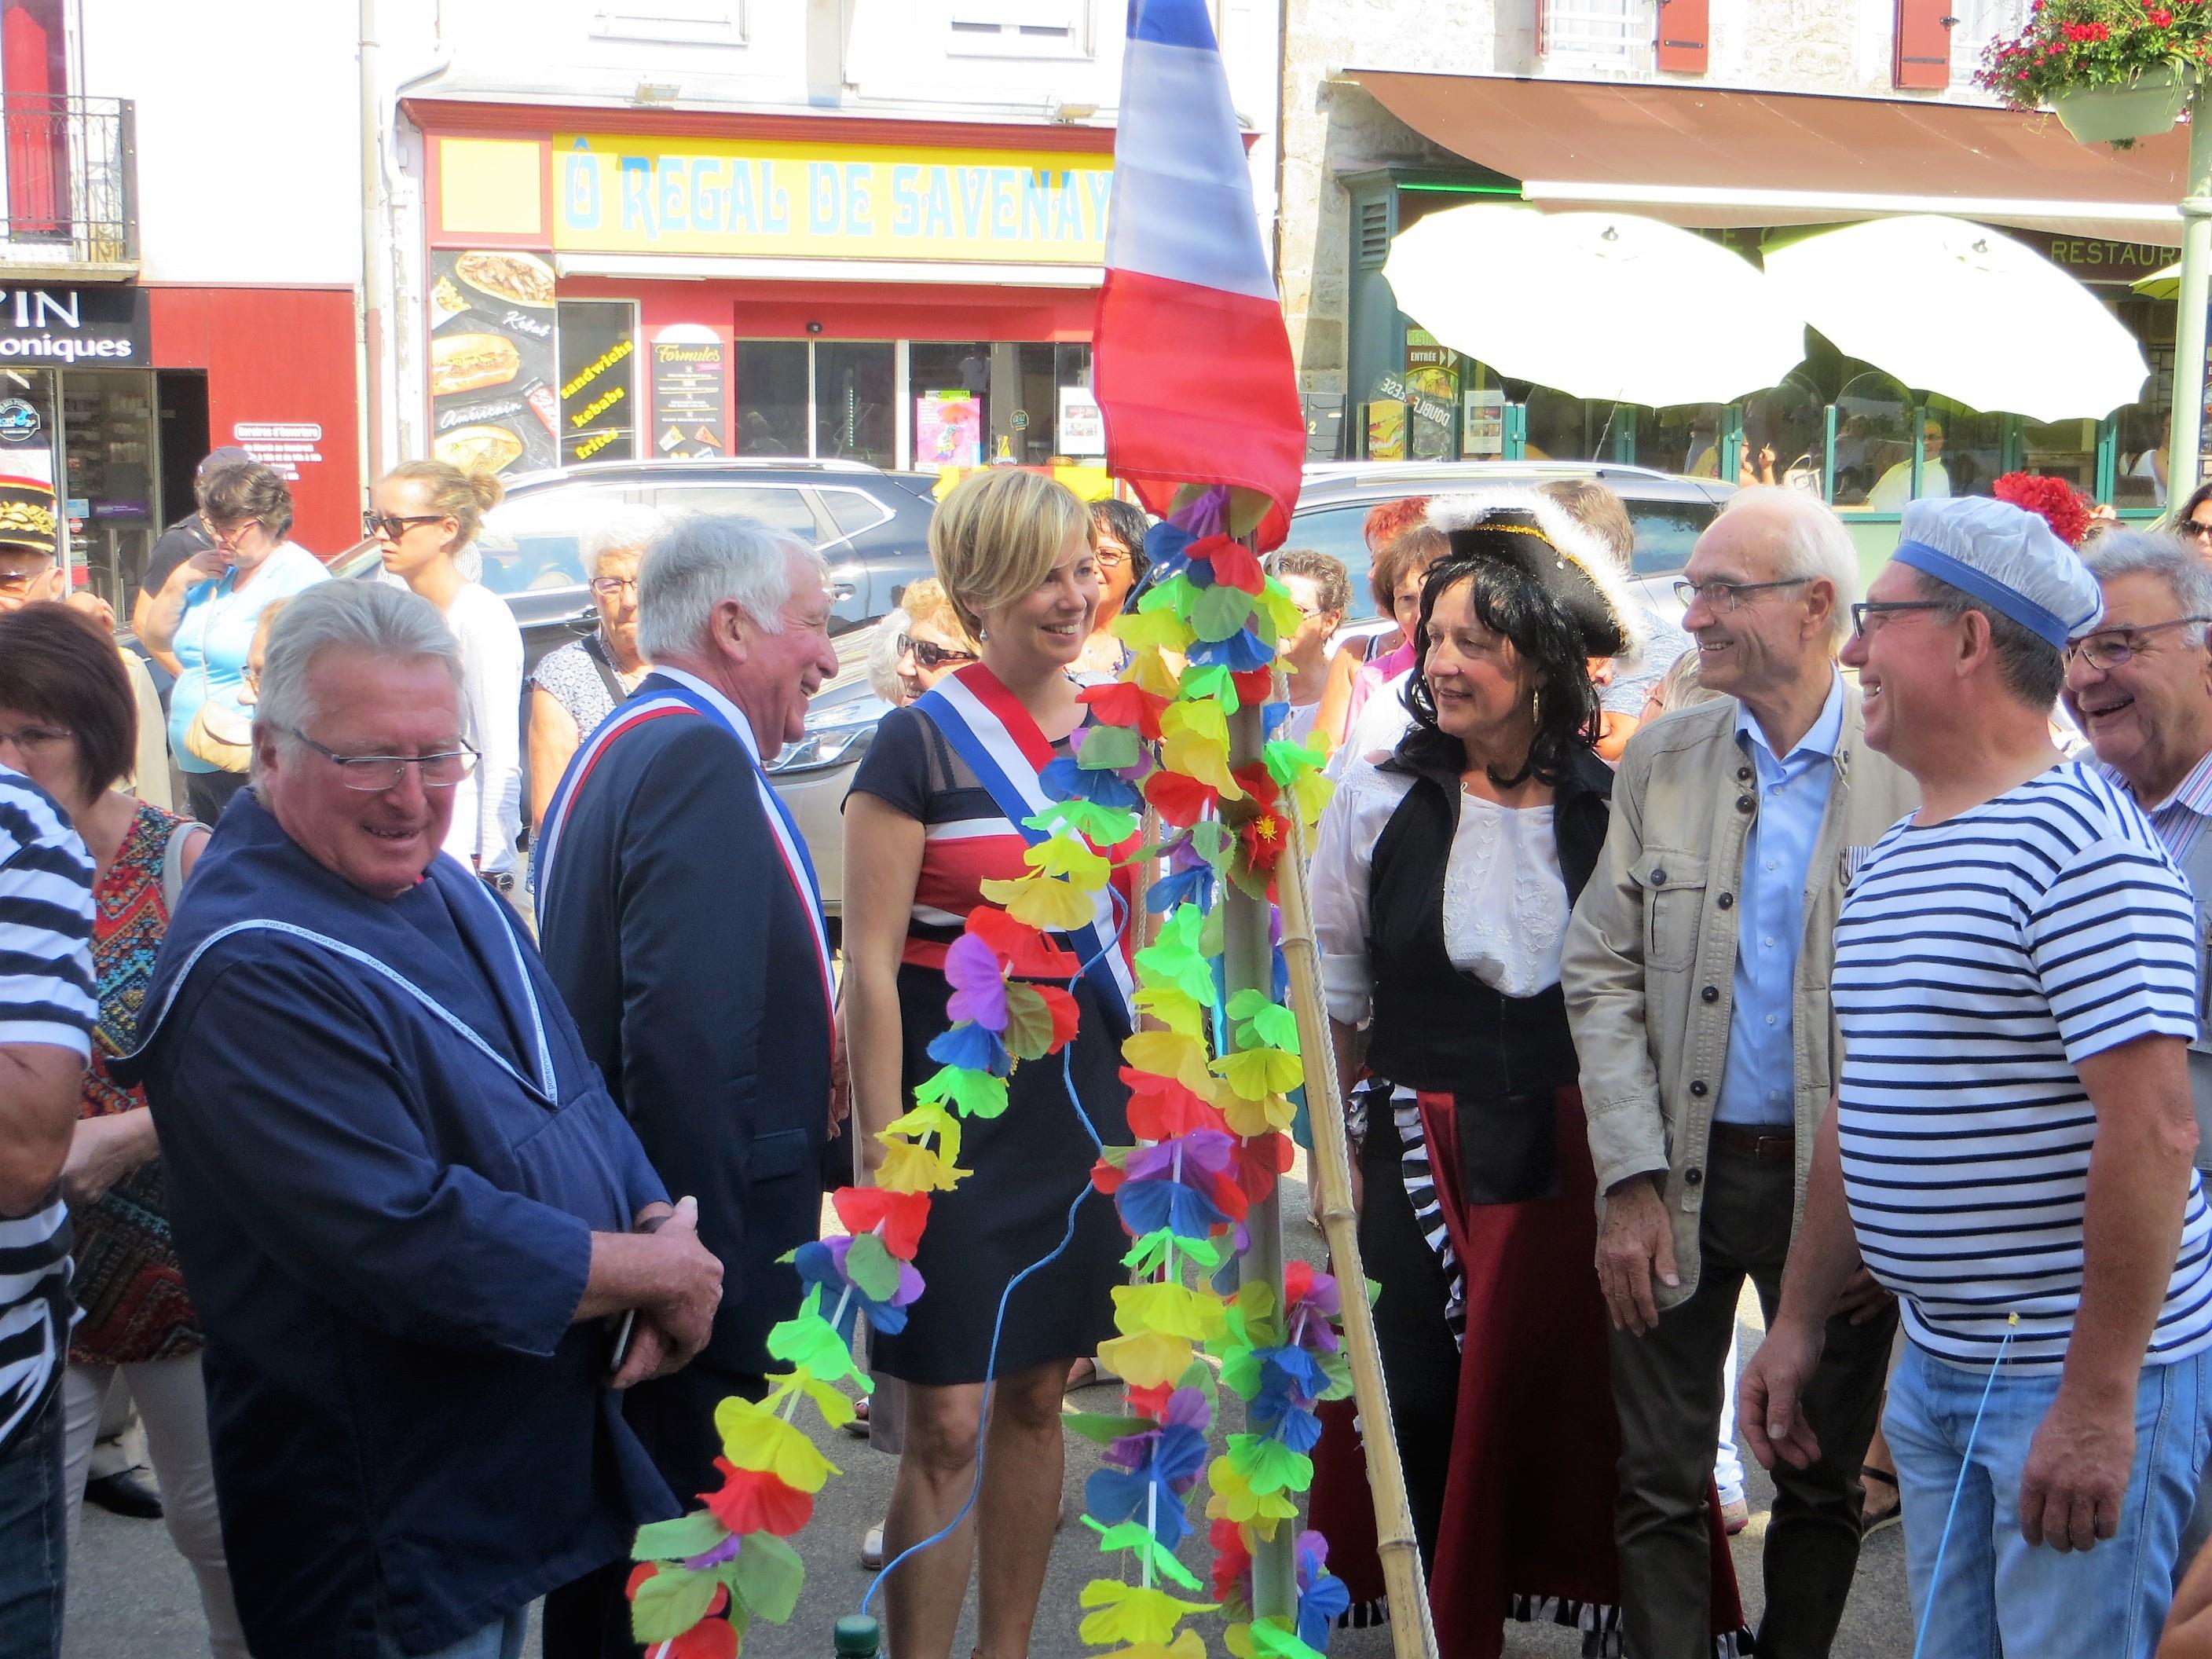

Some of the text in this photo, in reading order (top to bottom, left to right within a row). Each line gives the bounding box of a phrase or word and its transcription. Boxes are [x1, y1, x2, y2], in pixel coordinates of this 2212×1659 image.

[565, 137, 1114, 241] Ô REGAL DE SAVENAY
[0, 291, 80, 328] IN
[503, 310, 551, 338] Kebab
[561, 340, 633, 400] sandwichs
[655, 344, 720, 364] Formules
[1410, 350, 1437, 362] ENTRÉE
[571, 386, 625, 428] kebabs
[575, 428, 619, 460] frites
[1308, 421, 1317, 435] 2
